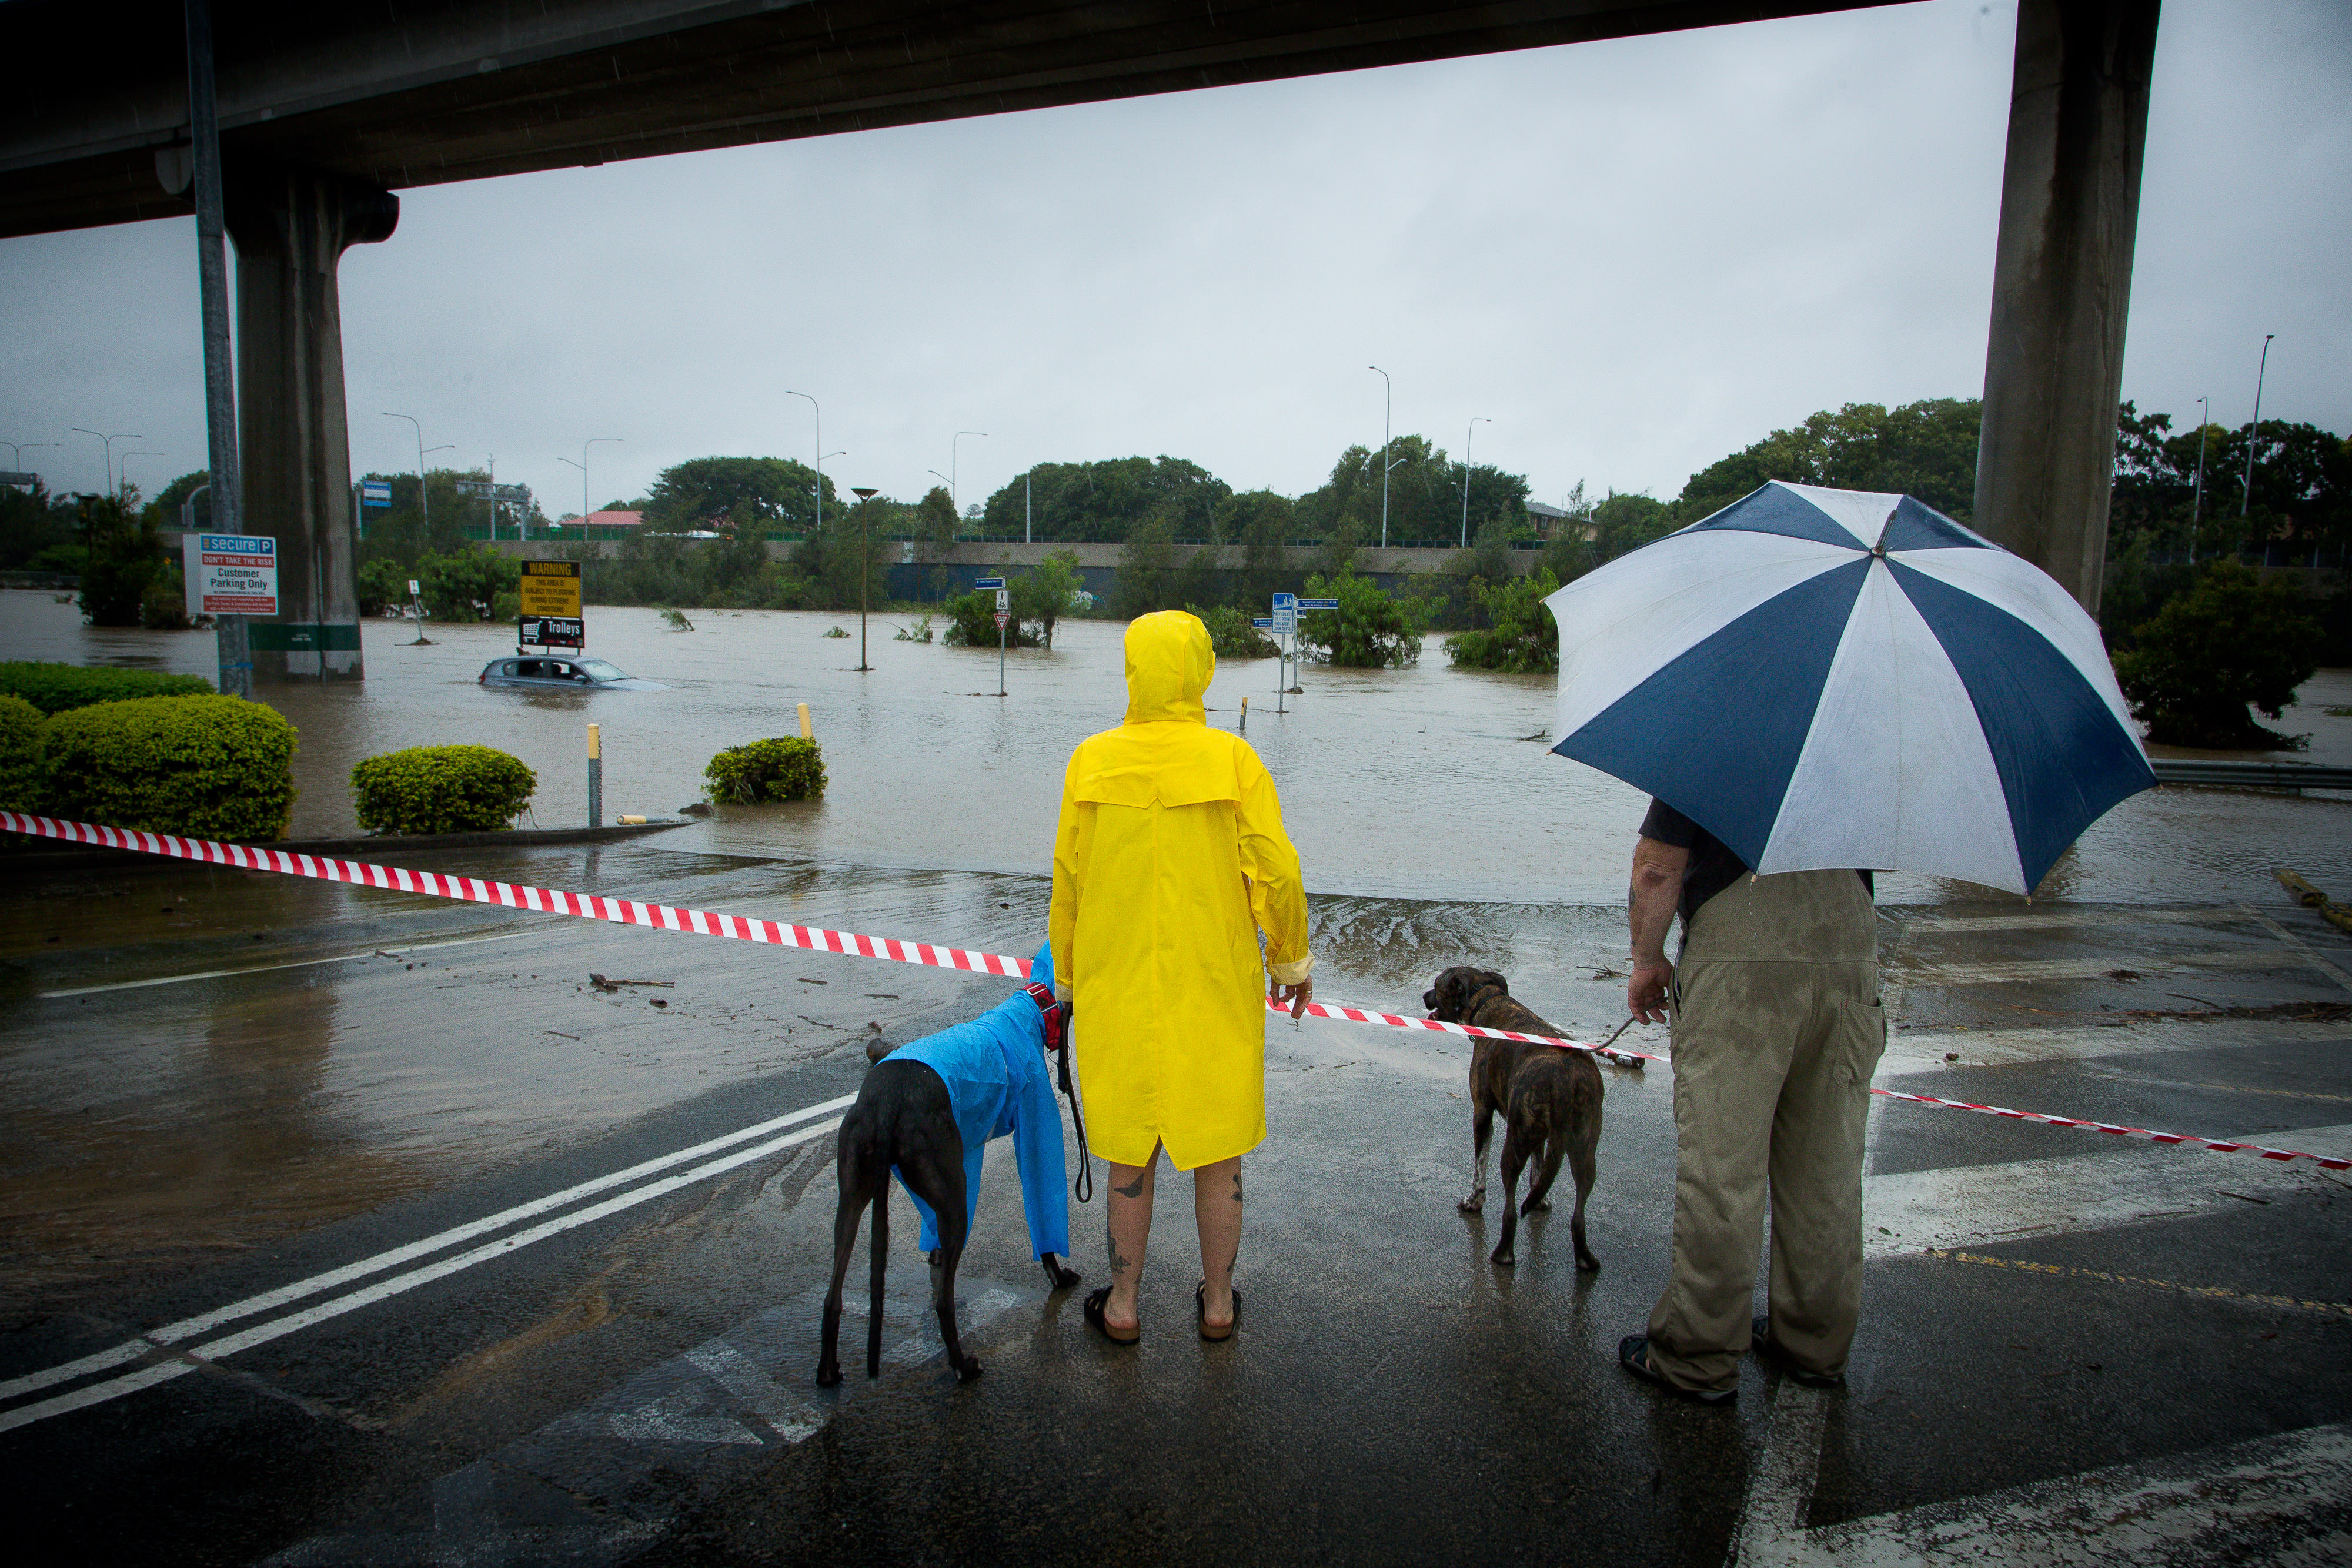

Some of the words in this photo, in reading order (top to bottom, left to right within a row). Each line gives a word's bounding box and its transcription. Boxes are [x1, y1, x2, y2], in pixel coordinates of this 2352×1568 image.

[211, 538, 256, 551] secure
[262, 540, 271, 552] P
[218, 567, 260, 578] Customer
[529, 562, 572, 576] WARNING
[211, 577, 246, 590] Parking
[248, 579, 268, 590] Only
[548, 621, 580, 636] Trolleys
